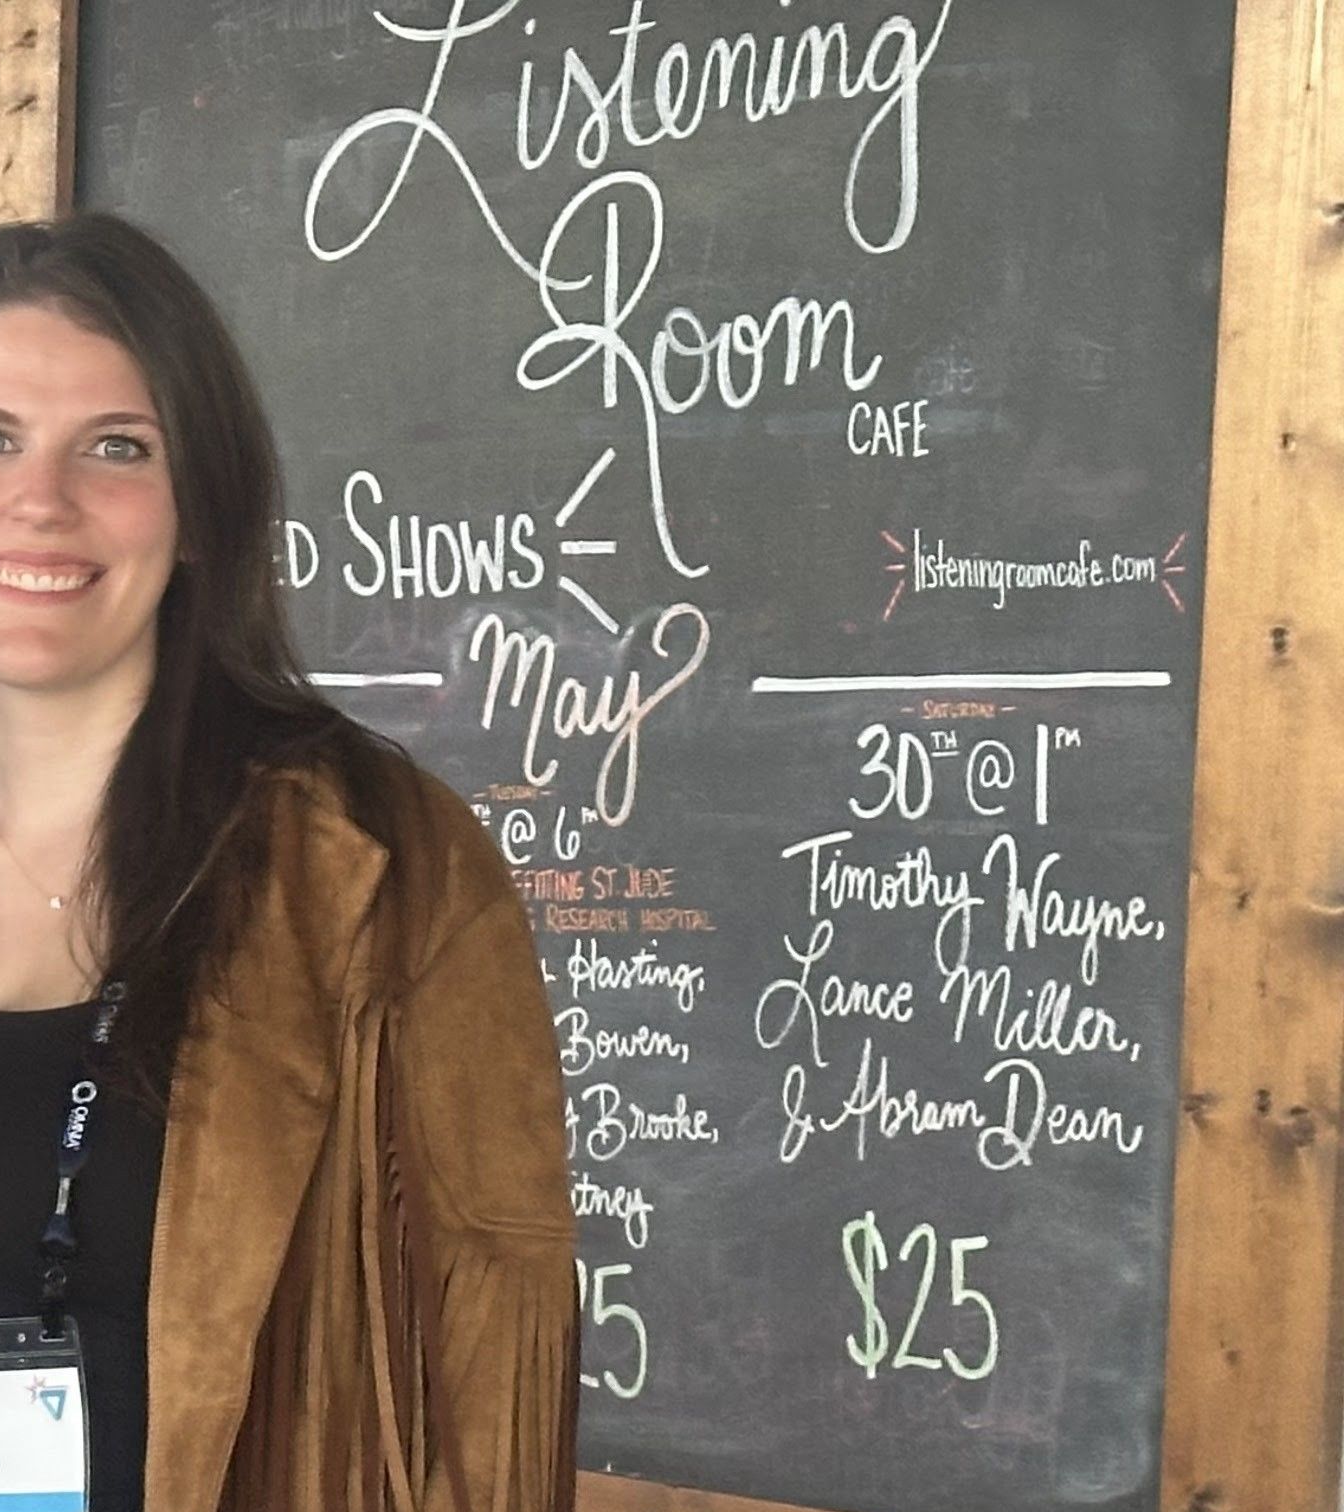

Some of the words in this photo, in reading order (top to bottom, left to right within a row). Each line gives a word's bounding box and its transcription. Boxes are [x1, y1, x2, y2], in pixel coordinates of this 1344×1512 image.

[304, 0, 952, 260] Listening
[847, 400, 929, 457] CAFE
[914, 528, 1156, 610] listeningroomcafe.com
[470, 603, 710, 827] May
[966, 740, 1014, 815] @
[781, 831, 985, 977] Timothy
[982, 834, 1165, 986] Wayne,
[939, 965, 1141, 1062] Miller,
[581, 1083, 719, 1161] Brooke,
[819, 1037, 987, 1161] Abram
[977, 1057, 1144, 1170] Dean
[842, 1210, 1000, 1380] $25
